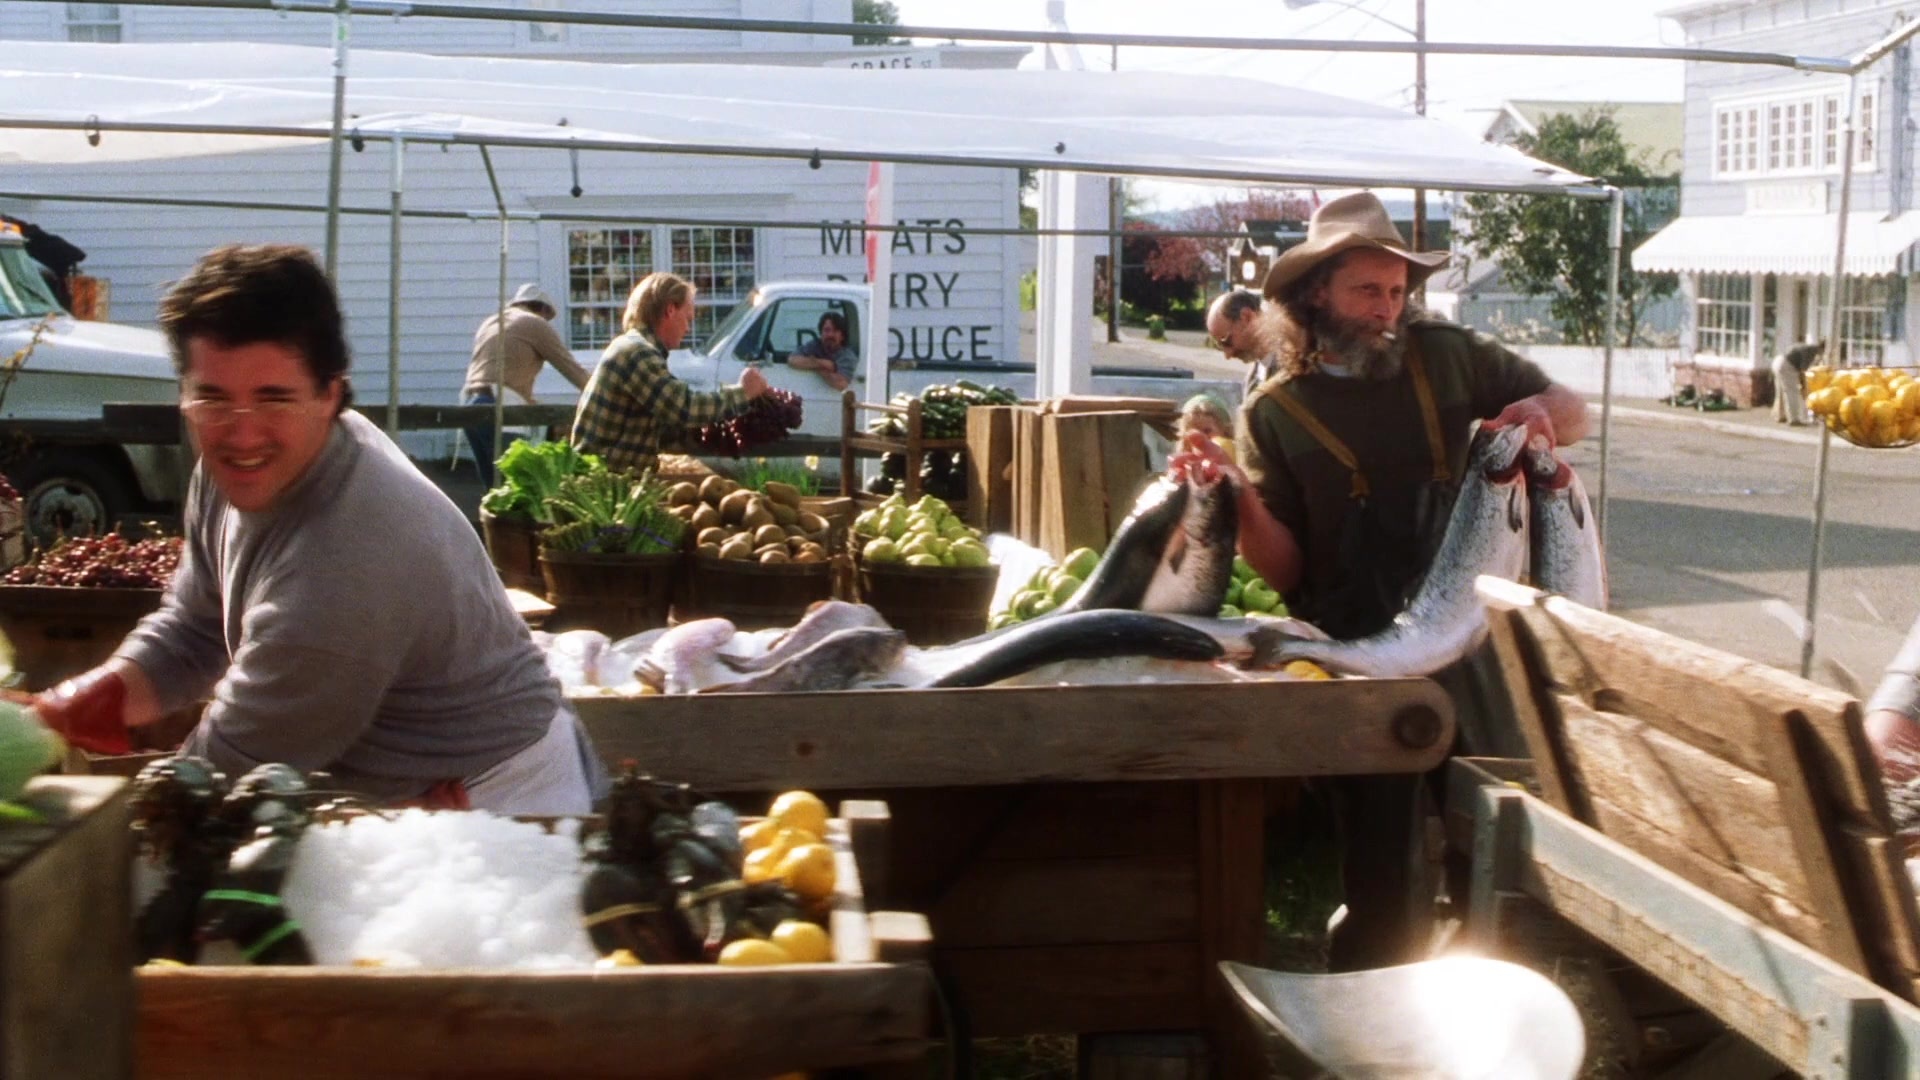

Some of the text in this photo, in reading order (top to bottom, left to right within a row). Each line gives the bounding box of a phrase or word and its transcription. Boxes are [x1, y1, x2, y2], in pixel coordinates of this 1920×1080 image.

[821, 218, 966, 254] MATS
[827, 273, 960, 308] IRY
[798, 326, 992, 361] PDUCE
